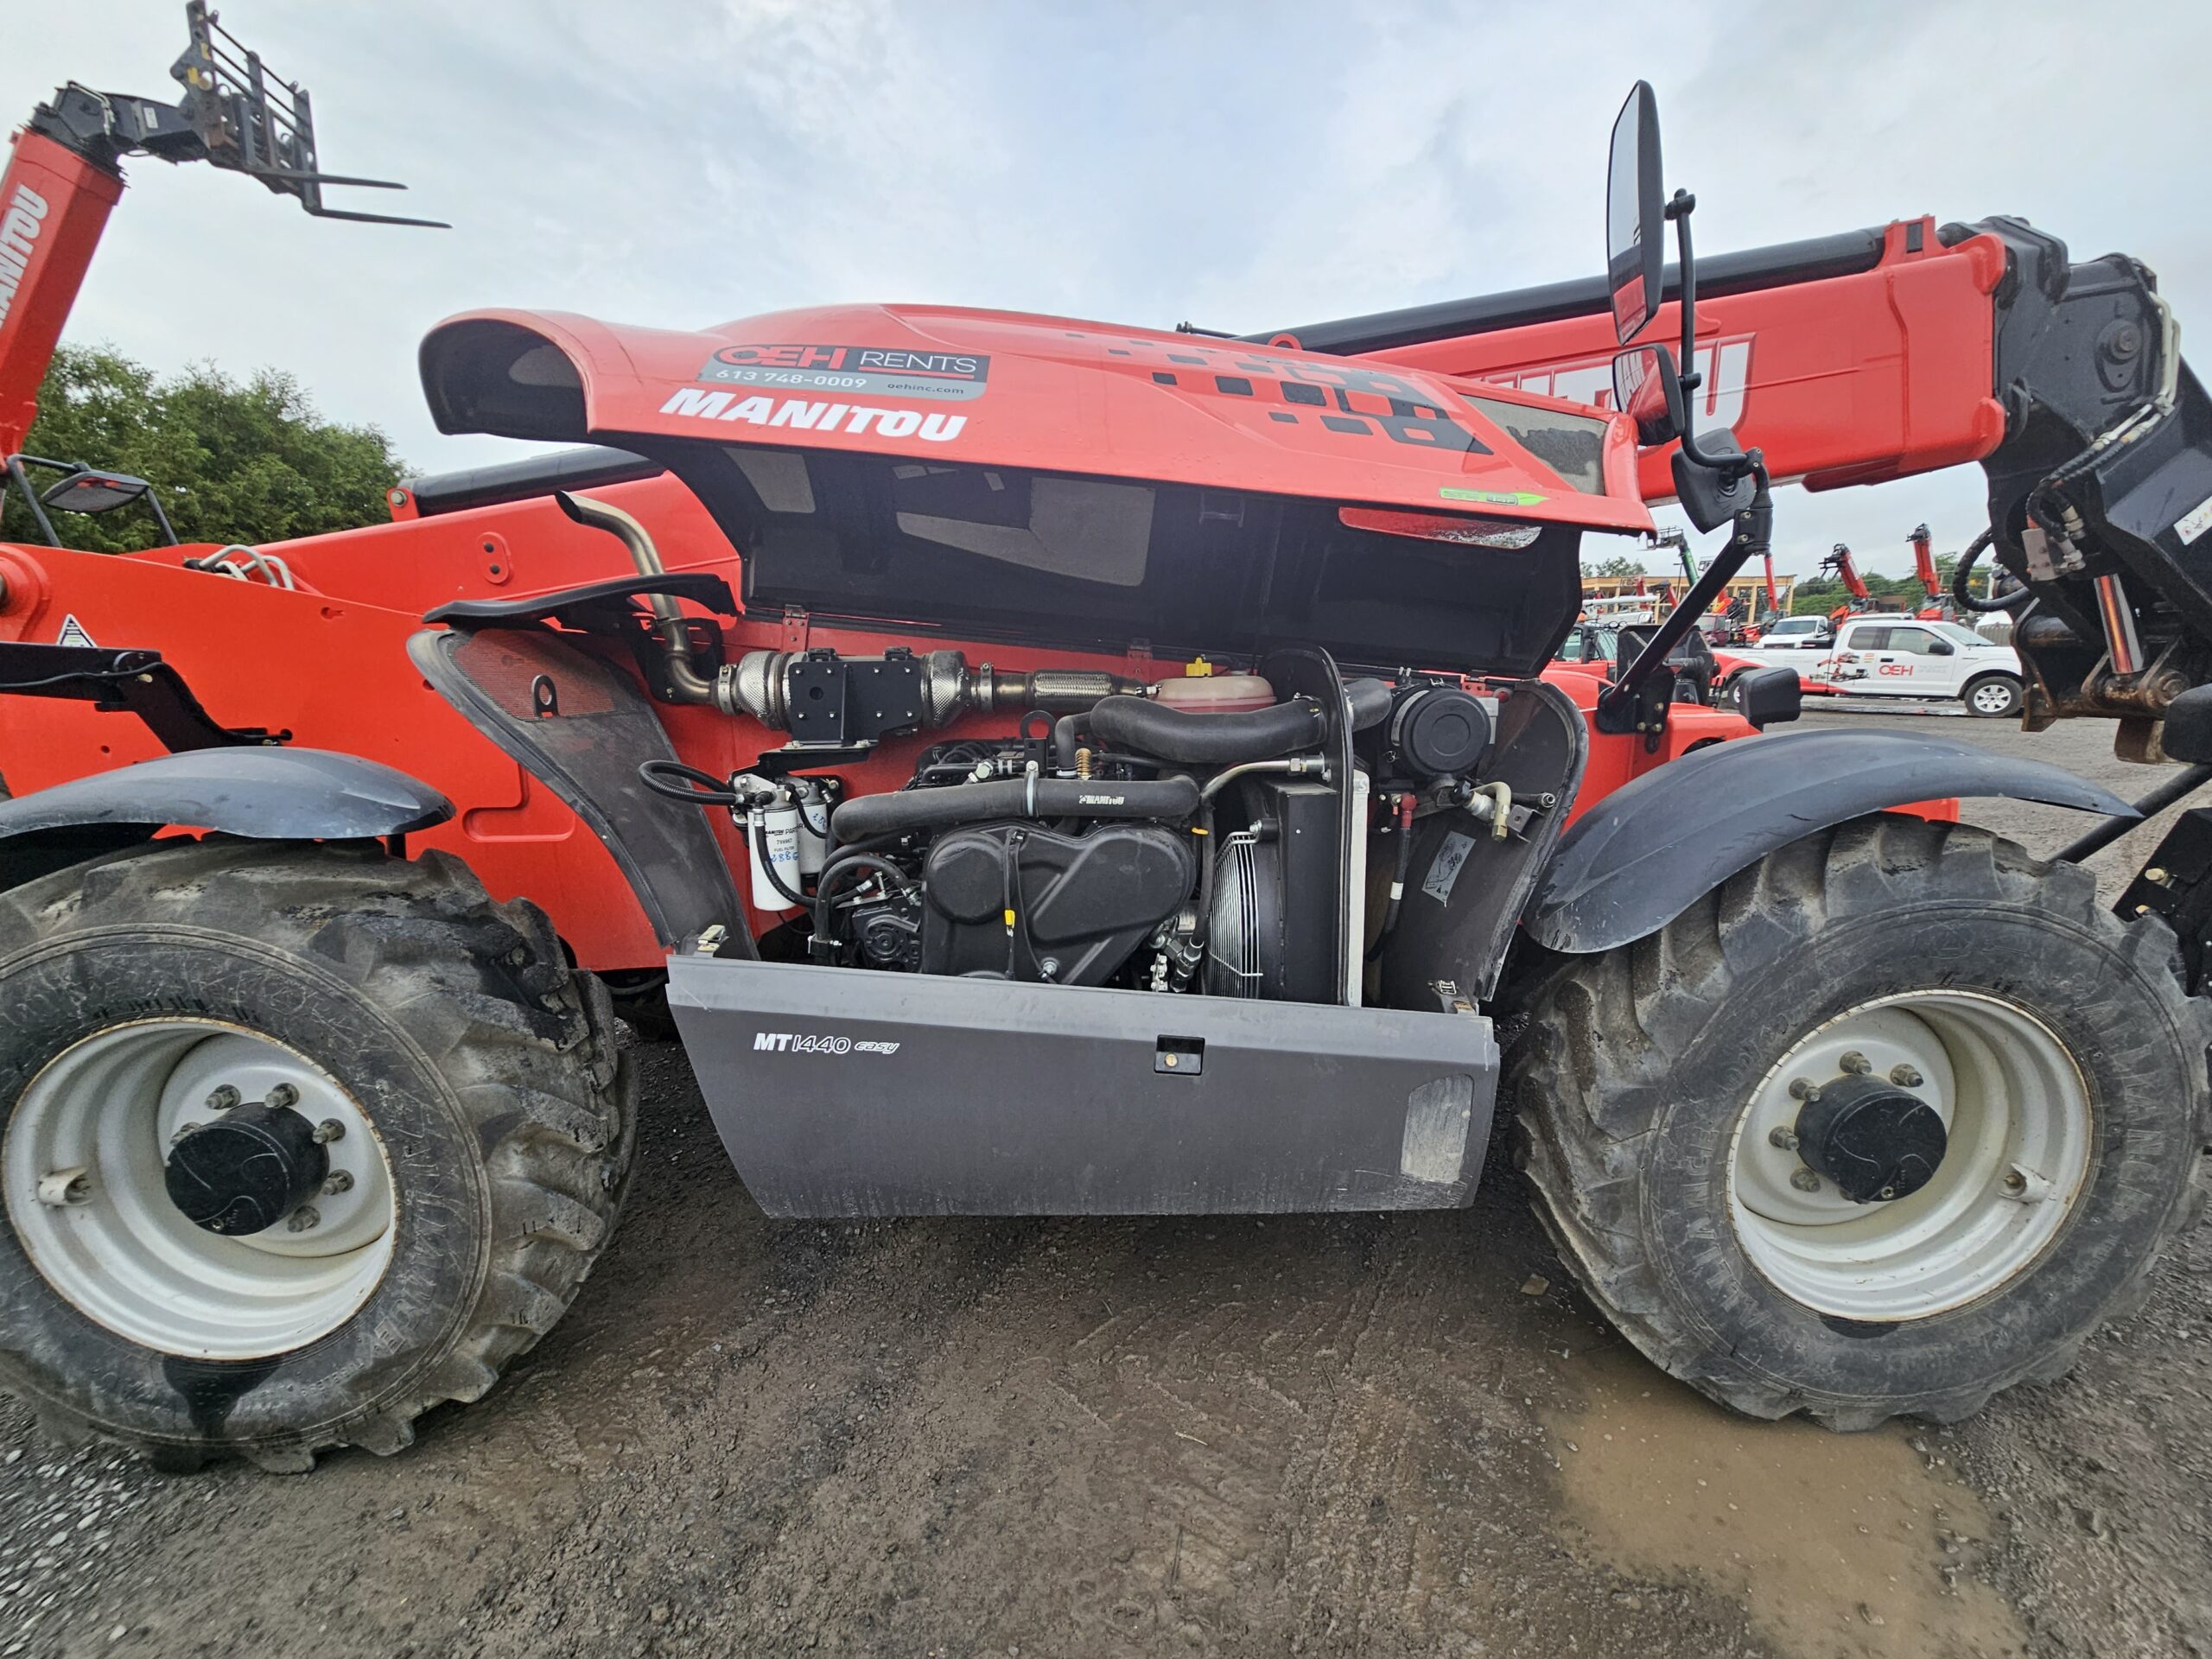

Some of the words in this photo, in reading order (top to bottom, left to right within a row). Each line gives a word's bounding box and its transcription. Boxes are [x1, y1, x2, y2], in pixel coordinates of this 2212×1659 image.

[861, 351, 976, 373] RENTS
[716, 369, 758, 381] 613
[764, 372, 868, 388] 748-0009
[887, 382, 964, 395] oehinc.com
[659, 388, 968, 442] MANITOU
[1878, 664, 1914, 676] OEH
[753, 1033, 851, 1054] MT1440
[854, 1041, 900, 1054] easy
